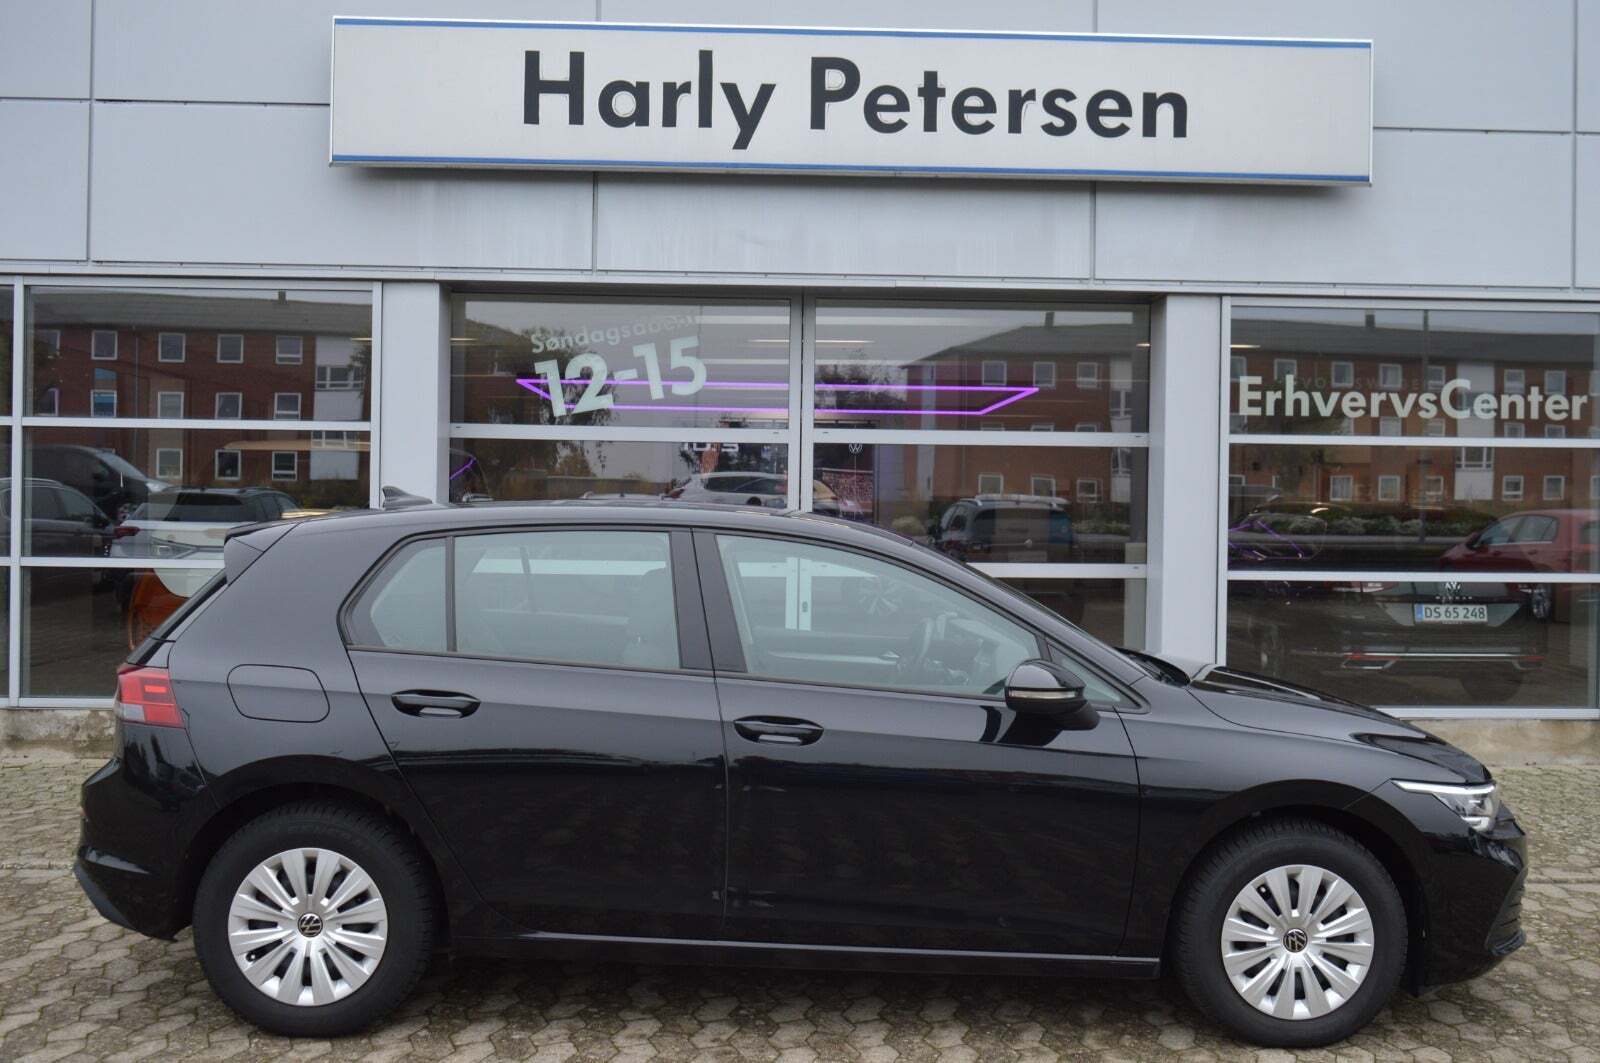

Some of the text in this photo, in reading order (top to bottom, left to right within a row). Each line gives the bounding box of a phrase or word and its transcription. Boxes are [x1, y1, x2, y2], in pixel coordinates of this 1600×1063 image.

[524, 49, 1188, 150] Harly Petersen
[534, 336, 708, 417] 12-15
[1238, 374, 1588, 422] ErhvervsCenter
[1424, 606, 1486, 620] DS 65 248
